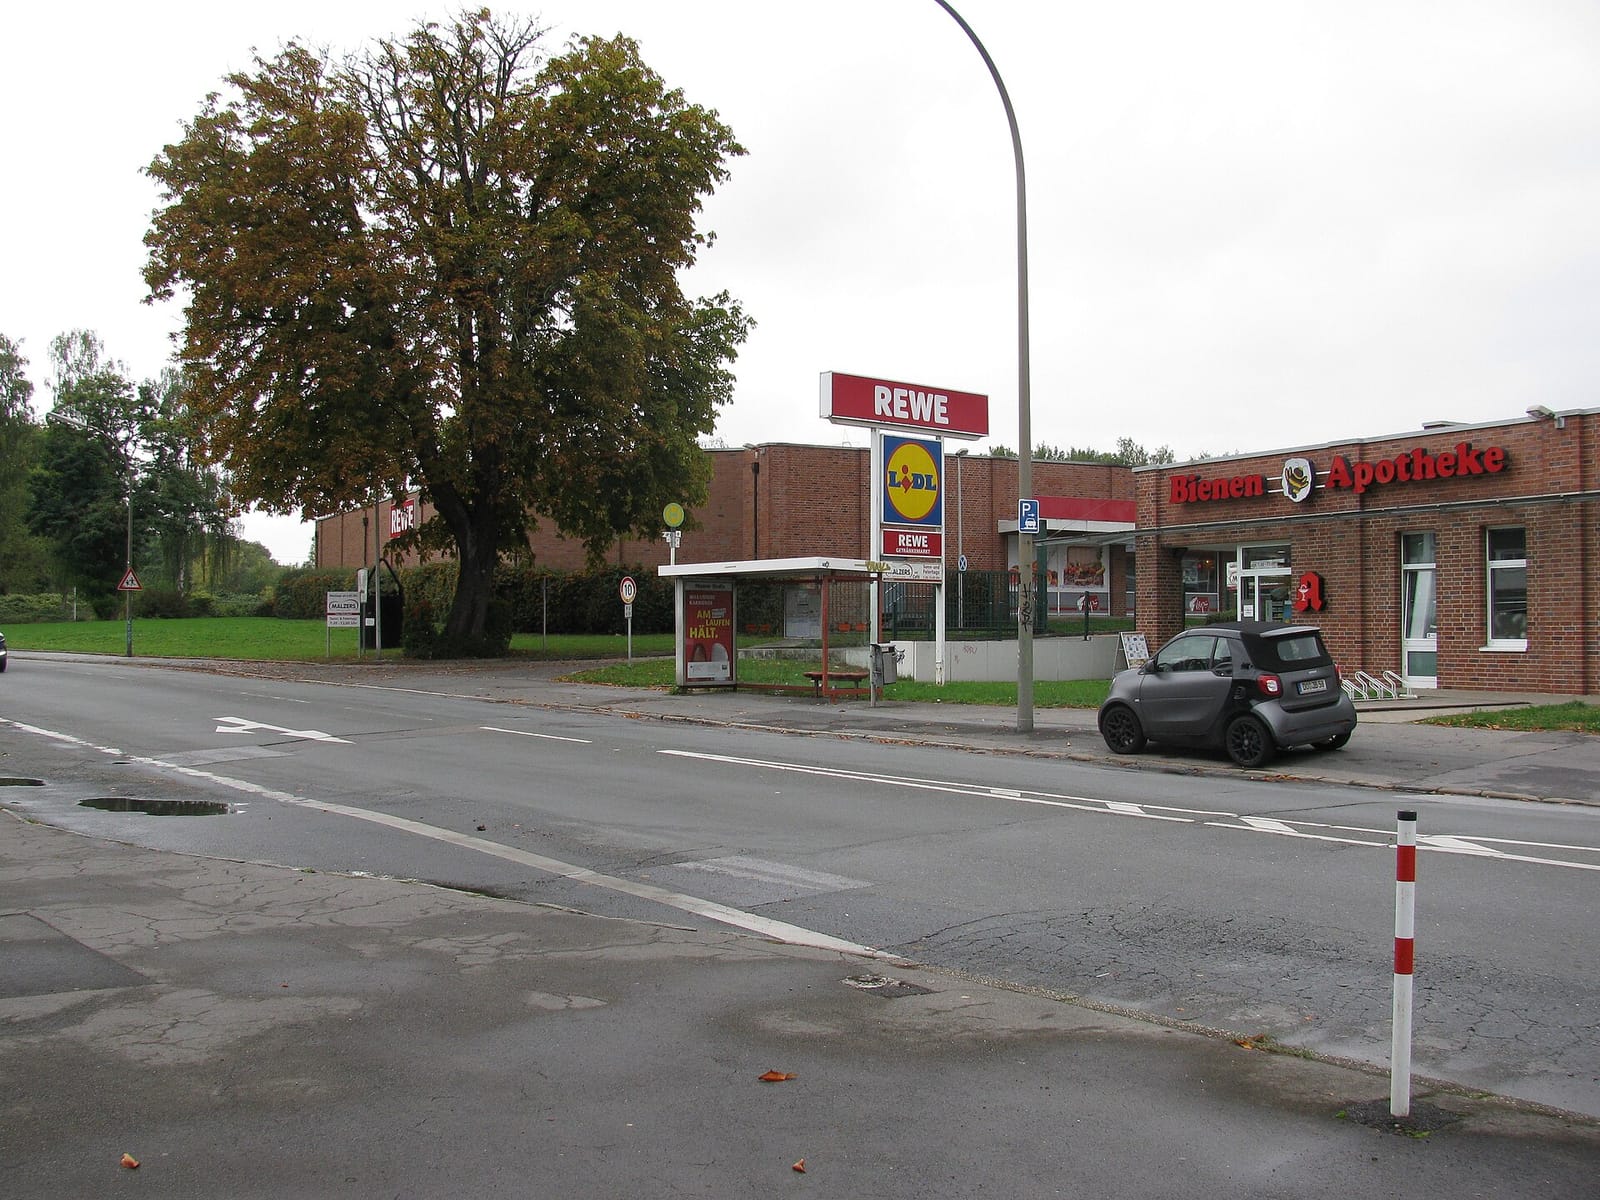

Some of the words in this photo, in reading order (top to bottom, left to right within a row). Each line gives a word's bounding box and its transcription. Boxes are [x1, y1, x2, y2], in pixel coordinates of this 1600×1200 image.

[874, 385, 949, 424] REWE
[1169, 473, 1264, 504] Bienen
[1324, 442, 1505, 493] Apotheke
[1022, 502, 1031, 517] P
[391, 504, 414, 534] REWE
[898, 534, 928, 548] REWE
[624, 583, 632, 596] 10
[696, 609, 711, 619] AM
[689, 624, 719, 639] HÄLT.
